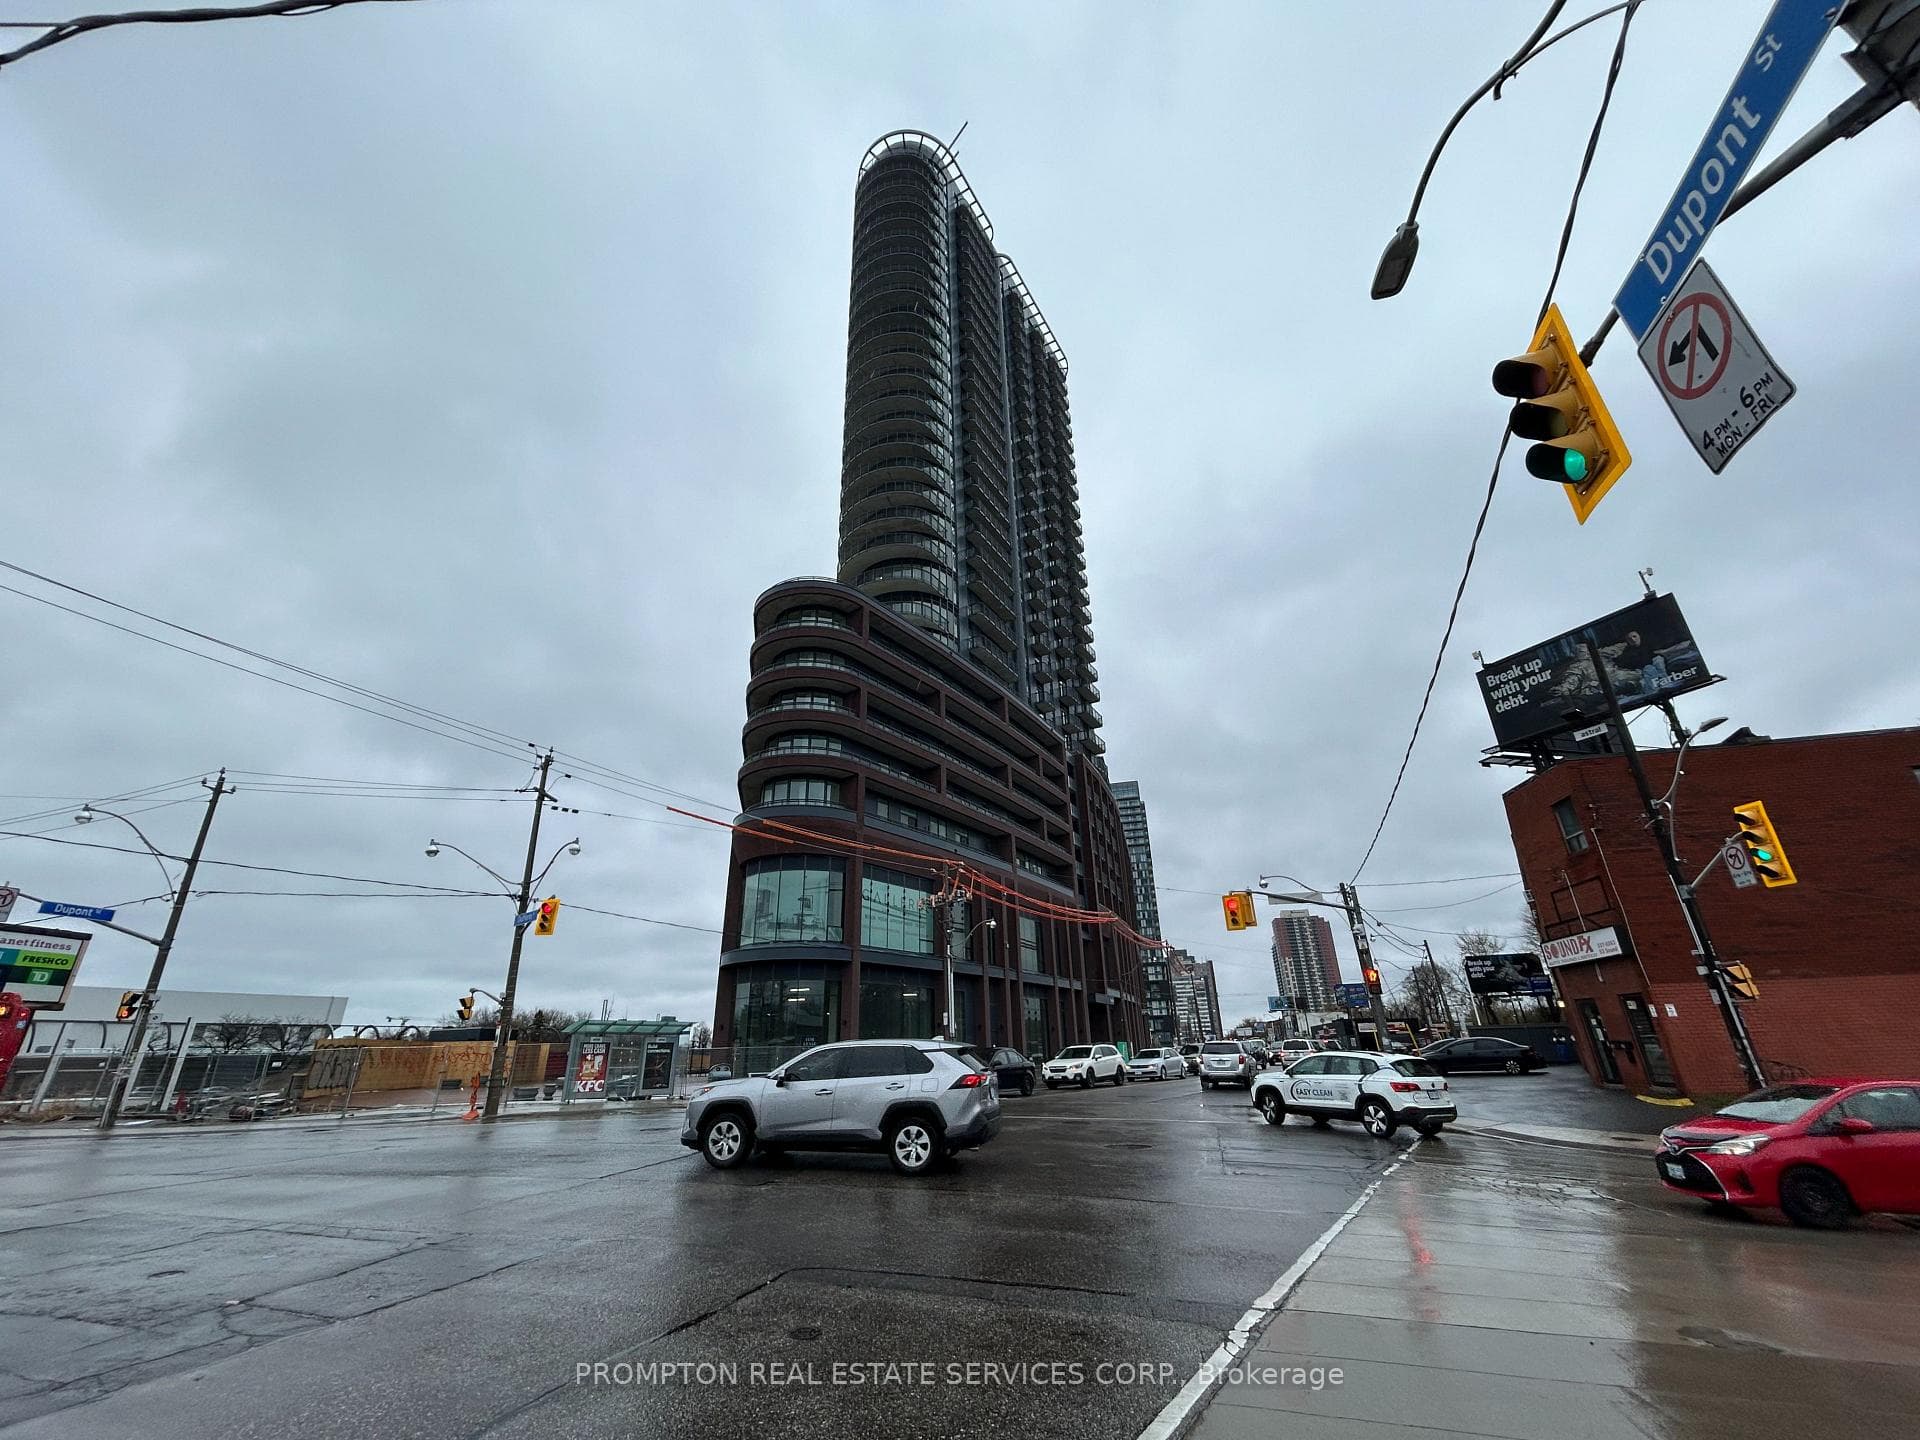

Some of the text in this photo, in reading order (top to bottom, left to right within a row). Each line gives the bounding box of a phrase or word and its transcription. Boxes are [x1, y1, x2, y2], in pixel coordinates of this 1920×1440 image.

[1645, 32, 1783, 285] Dupont St
[1715, 426, 1743, 457] MON
[1750, 393, 1775, 421] FRI
[1486, 659, 1542, 687] Break up
[1651, 666, 1697, 688] Farber
[1490, 669, 1551, 699] with your
[1495, 694, 1528, 713] debt.
[54, 903, 93, 917] Dupont
[30, 939, 72, 950] fitness
[22, 955, 69, 966] FRESHCO
[31, 971, 49, 982] TD
[574, 1079, 605, 1092] KFC
[1296, 1088, 1311, 1096] EASY
[1312, 1089, 1333, 1097] CLEAN
